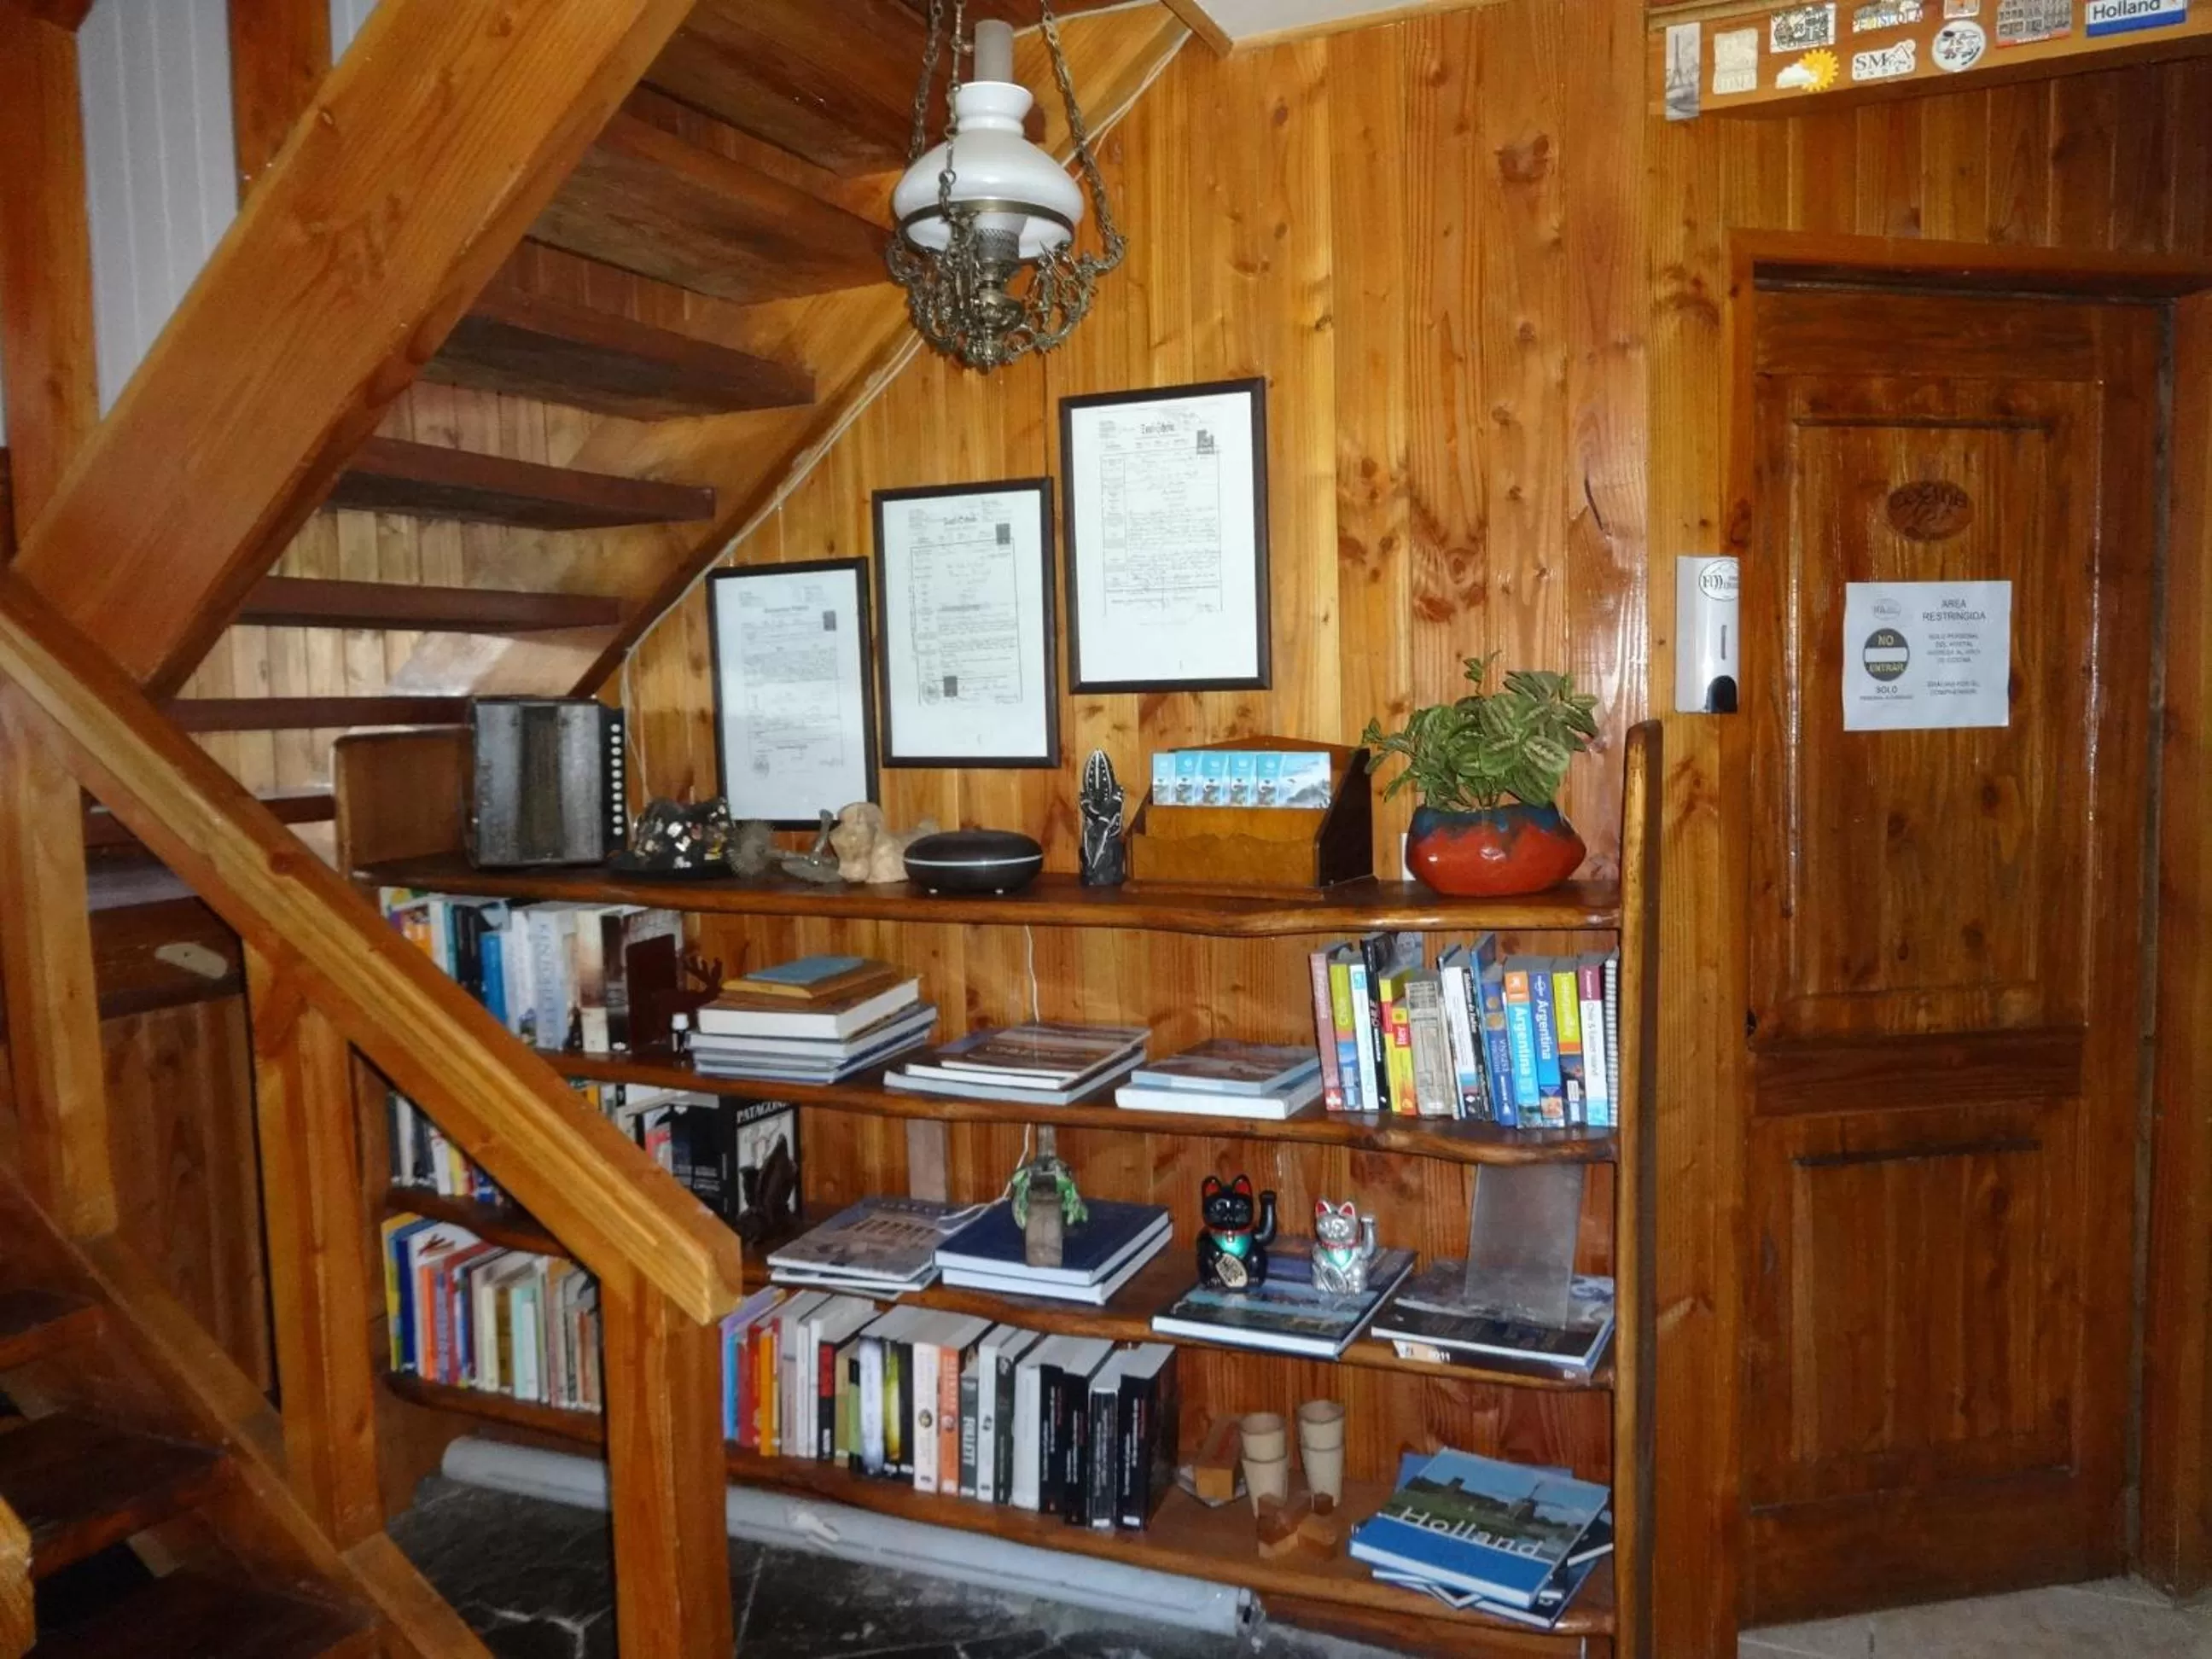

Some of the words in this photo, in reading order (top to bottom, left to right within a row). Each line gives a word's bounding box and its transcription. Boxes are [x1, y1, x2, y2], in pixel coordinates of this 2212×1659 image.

[2093, 0, 2160, 20] Holland
[1877, 636, 1895, 646] NO
[1922, 611, 1987, 621] RESTRINGIDA
[1514, 1007, 1532, 1076] Argentina
[1536, 1000, 1553, 1059] Argentina
[962, 1415, 976, 1468] FOLLETT
[1398, 1505, 1545, 1557] Holland
